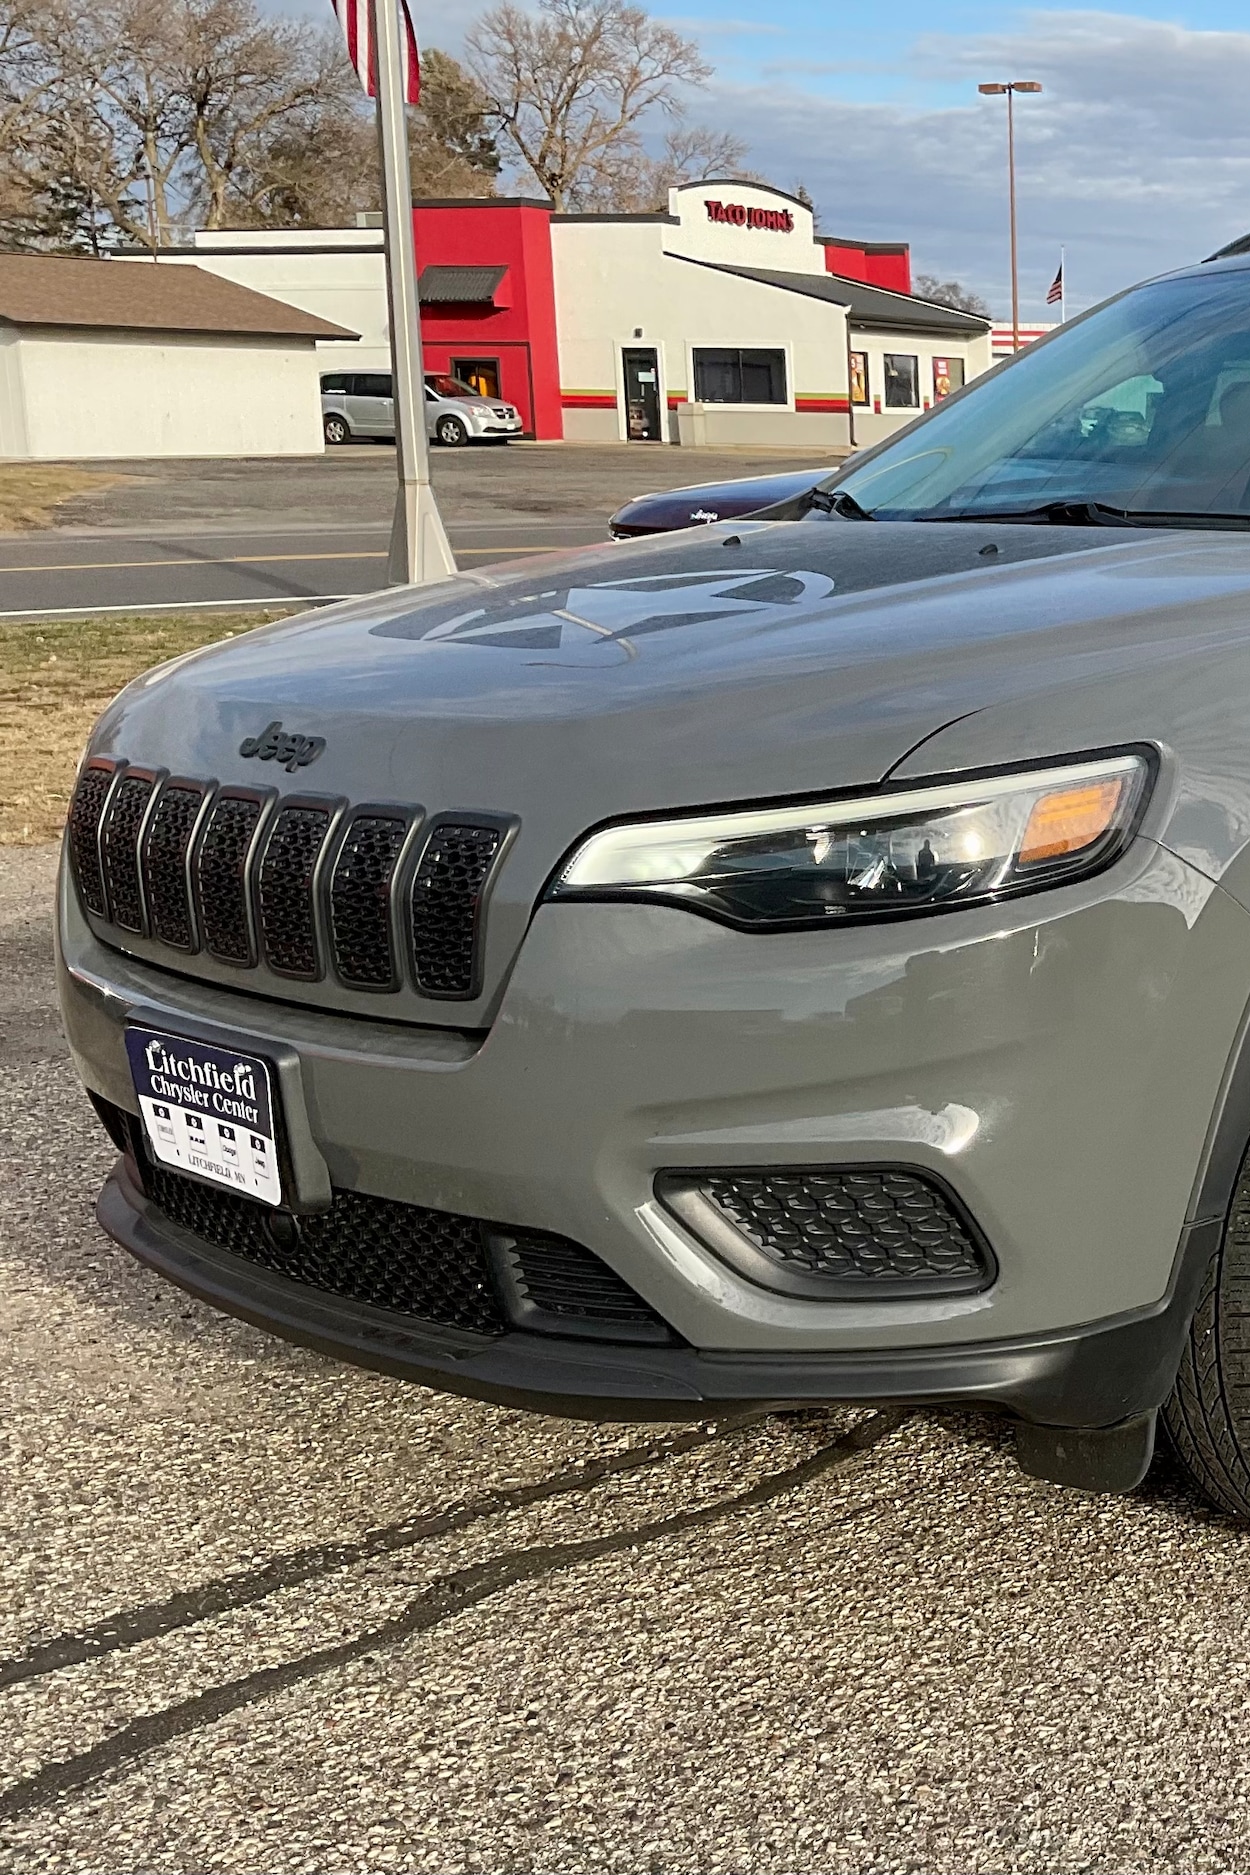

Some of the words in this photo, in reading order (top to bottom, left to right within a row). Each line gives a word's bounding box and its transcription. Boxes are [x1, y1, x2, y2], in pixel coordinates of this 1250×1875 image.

[704, 200, 747, 227] TACO
[746, 207, 795, 234] JOHN'S
[239, 721, 327, 774] Jeep
[145, 1042, 257, 1101] Litchfield
[150, 1074, 209, 1108] Chrysler
[212, 1092, 259, 1124] Center
